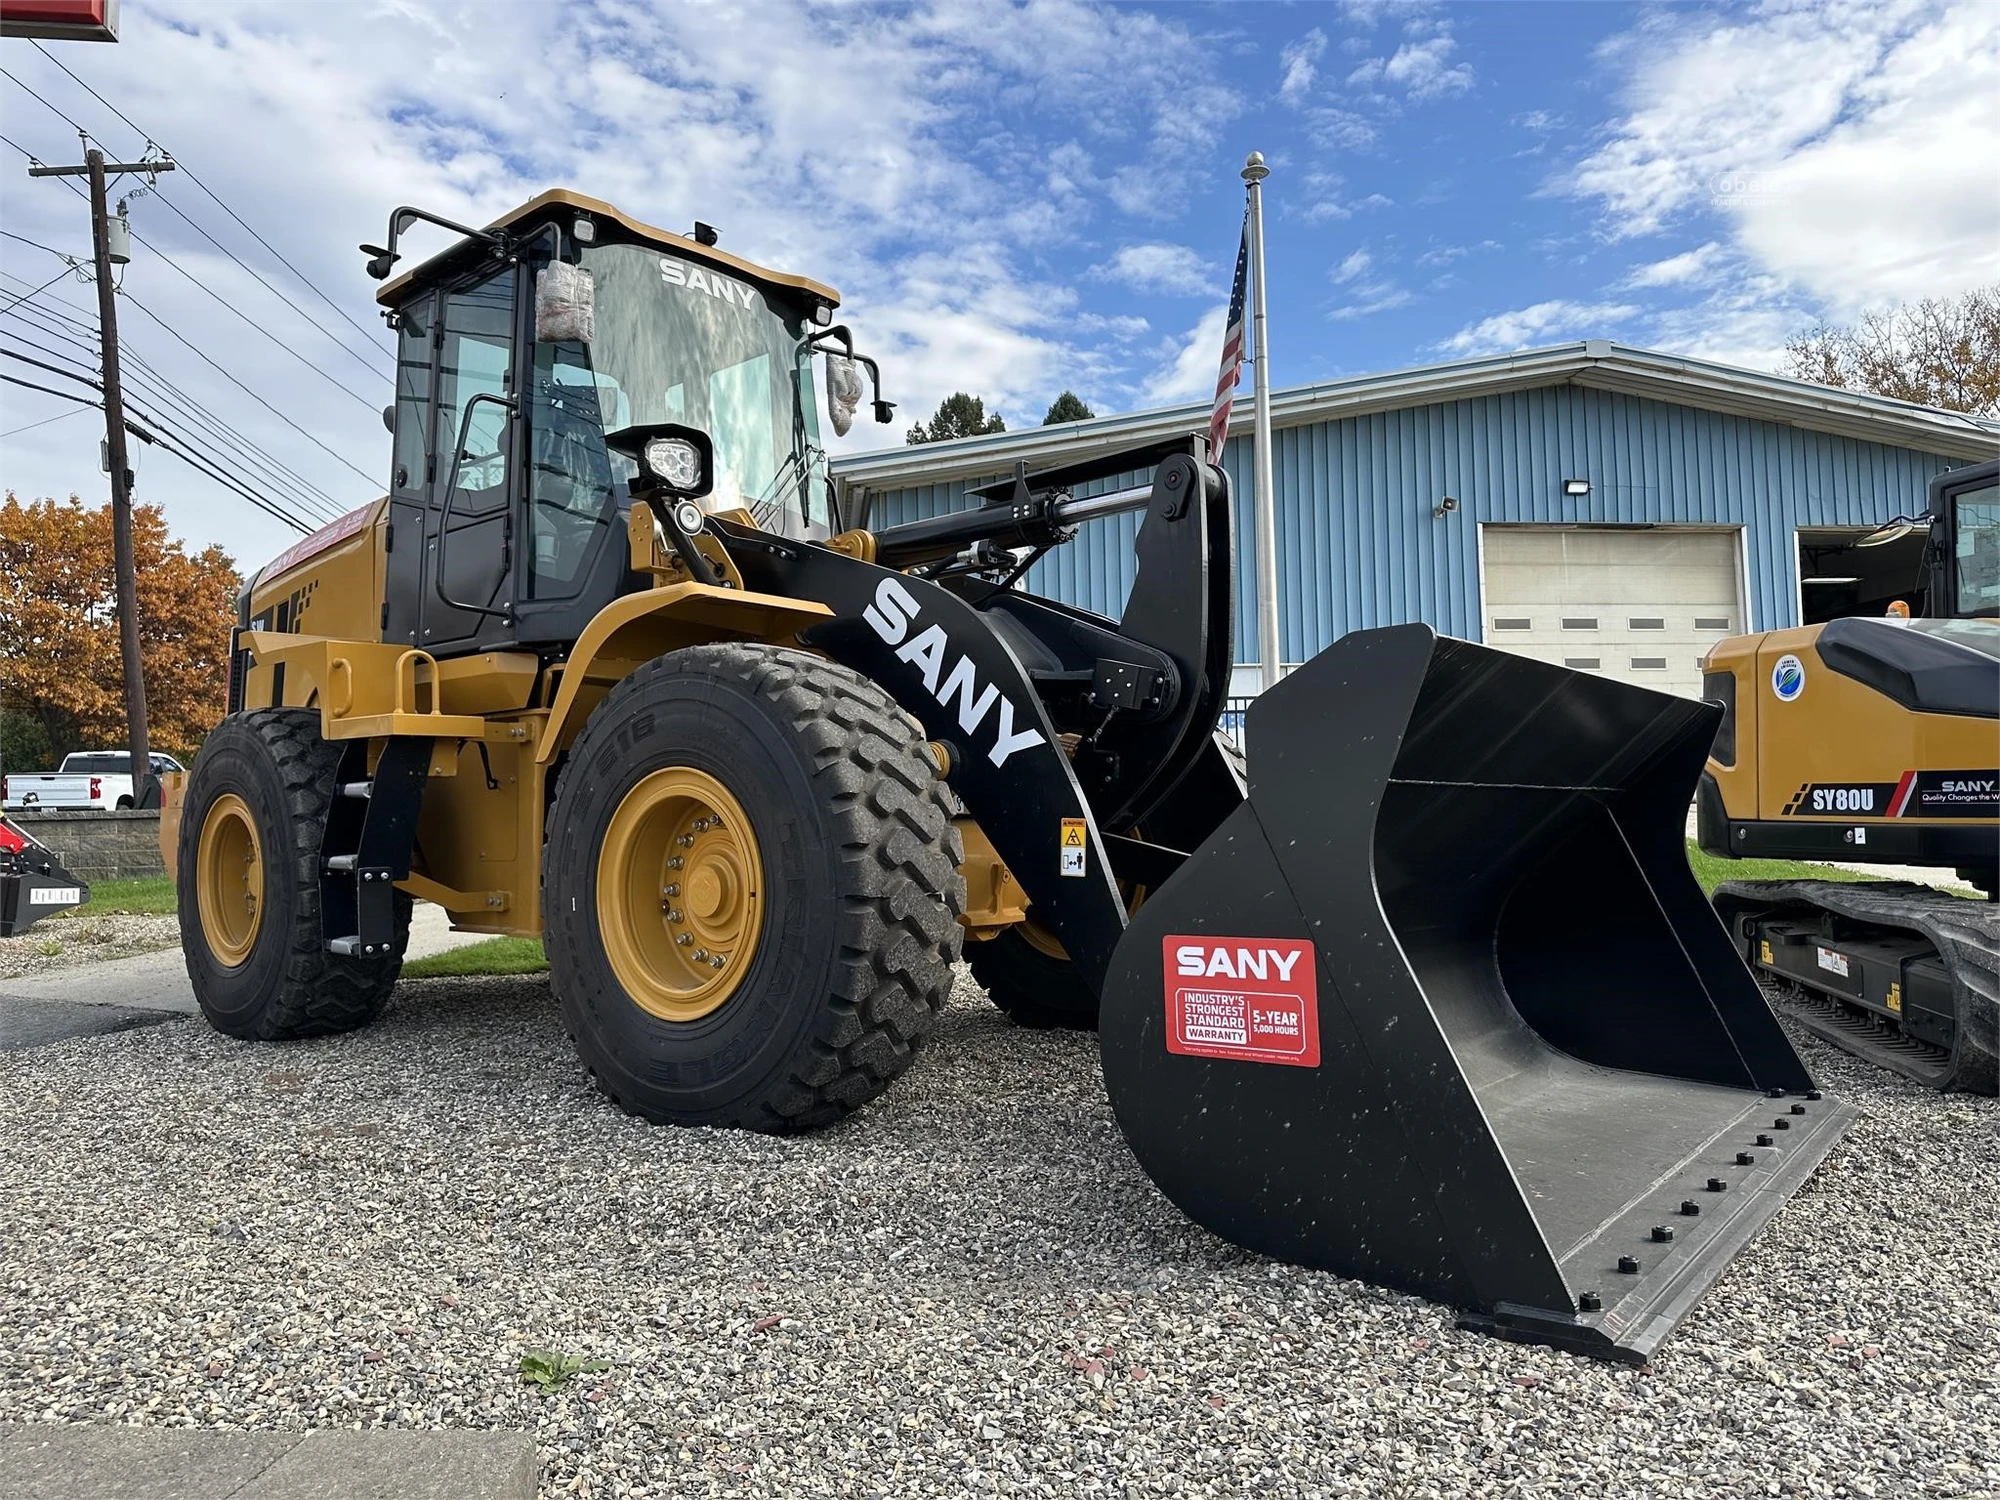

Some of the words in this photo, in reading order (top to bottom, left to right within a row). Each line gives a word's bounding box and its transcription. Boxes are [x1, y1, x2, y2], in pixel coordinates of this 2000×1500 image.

[659, 258, 756, 311] SANY
[862, 577, 1046, 769] SANY
[1941, 780, 1995, 792] SANY
[1812, 788, 1874, 811] SY80U
[1922, 794, 1946, 803] Quality
[1947, 793, 1978, 803] Changes
[1176, 945, 1302, 982] SANY
[1184, 992, 1245, 1006] INDUSTRY'S
[1185, 1003, 1245, 1017] STRONGEST
[1185, 1014, 1246, 1029] STANDARD
[1188, 1028, 1244, 1042] WARRANTY
[1253, 1024, 1274, 1034] 5,000
[1274, 1026, 1299, 1036] HOURS
